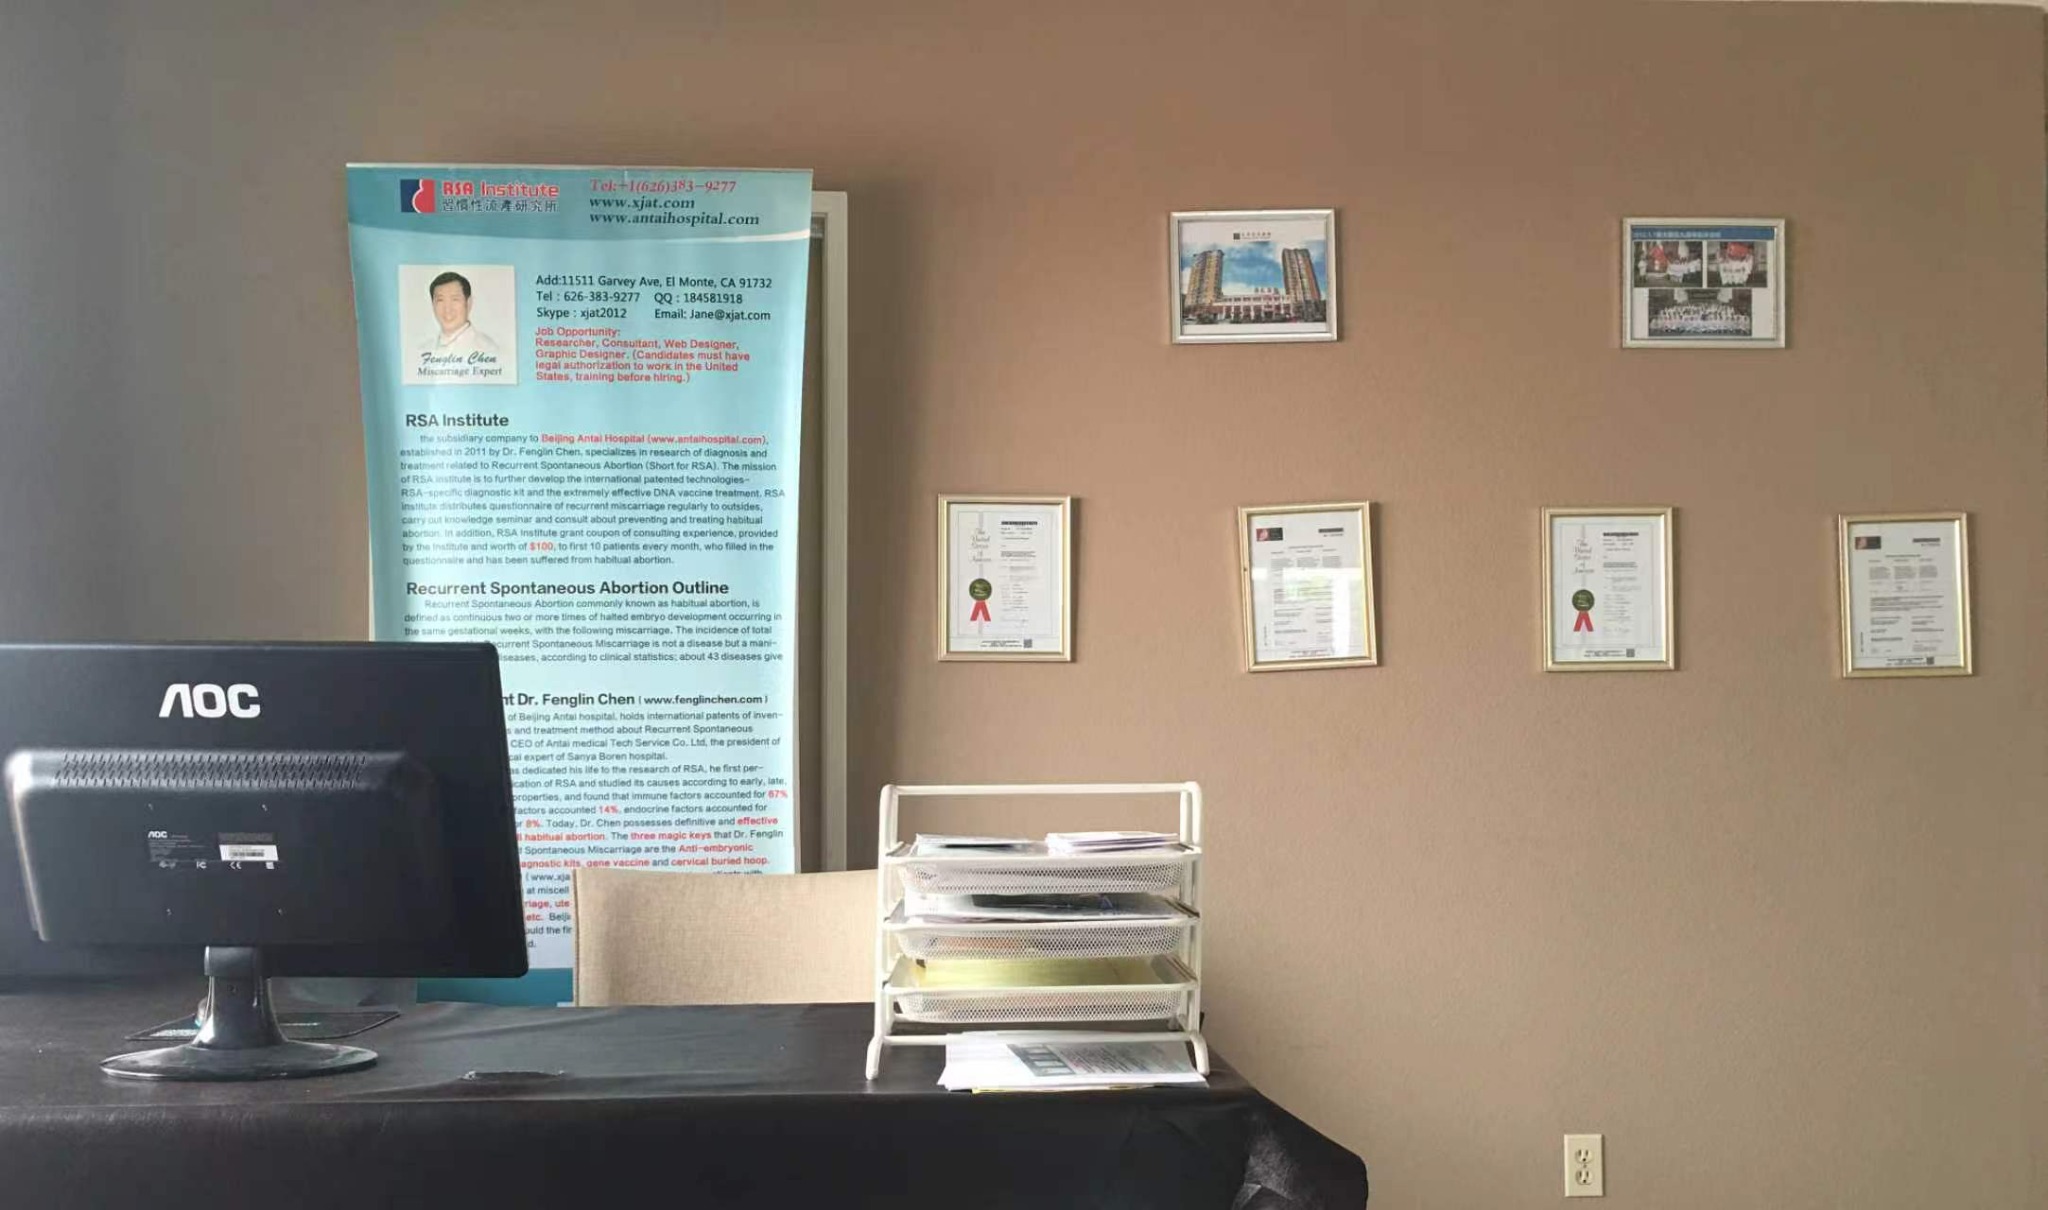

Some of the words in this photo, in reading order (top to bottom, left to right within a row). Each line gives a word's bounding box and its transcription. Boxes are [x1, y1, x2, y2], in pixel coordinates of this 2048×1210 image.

[442, 181, 474, 196] RSA
[481, 181, 560, 197] Institute
[590, 196, 695, 211] www.xjat.com
[590, 212, 760, 227] www.antaihospital.com
[536, 275, 594, 286] Add:11511
[598, 276, 636, 289] Garvey
[639, 276, 662, 289] Ave,
[666, 276, 675, 287] El
[680, 277, 718, 289] Monte,
[721, 277, 736, 288] CA
[739, 277, 772, 288] 91732
[537, 290, 552, 301] Tel
[564, 291, 640, 302] 626-383-9277
[654, 292, 673, 304] QQ
[684, 292, 743, 303] 184581918
[537, 307, 570, 320] Skype
[580, 307, 627, 321] xjat2012
[655, 308, 688, 319] Email:
[689, 309, 771, 322] Jane@xjat.com
[536, 327, 553, 336] Job
[556, 327, 620, 338] Opportunity:
[602, 338, 661, 349] Consultant,
[664, 339, 687, 348] Web
[690, 339, 740, 350] Designer,
[468, 350, 496, 364] Chen
[536, 349, 576, 360] Graphic
[633, 350, 694, 361] (Candidates
[698, 351, 722, 360] must
[725, 351, 750, 360] have
[536, 360, 561, 371] legal
[564, 360, 632, 370] authorization
[634, 361, 644, 370] to
[646, 361, 672, 370] work
[674, 361, 683, 370] in
[686, 361, 702, 371] the
[705, 361, 738, 371] United
[417, 367, 469, 377] Miscarriage
[473, 367, 502, 377] Expert
[537, 371, 573, 381] States,
[576, 371, 614, 382] training
[617, 372, 651, 381] before
[654, 372, 690, 383] hiring.)
[406, 414, 439, 427] RSA
[443, 414, 509, 427] Institute
[420, 434, 434, 443] the
[437, 434, 484, 444] subsidiary
[486, 436, 528, 445] company
[529, 435, 539, 443] to
[541, 435, 575, 445] Beijing
[577, 435, 602, 443] Antai
[605, 435, 645, 445] Hospital
[400, 448, 452, 456] established
[454, 448, 462, 456] in
[464, 448, 486, 456] 2011
[489, 448, 500, 458] by
[502, 448, 518, 457] Dr.
[519, 448, 553, 458] Fenglin
[586, 448, 637, 459] specializes
[639, 448, 648, 457] in
[649, 448, 690, 457] research
[693, 449, 702, 457] of
[704, 449, 748, 459] diagnosis
[750, 449, 768, 458] and
[400, 461, 444, 470] treatment
[446, 461, 478, 470] related
[480, 461, 490, 470] to
[492, 461, 538, 470] Recurrent
[540, 461, 602, 472] Spontaneous
[603, 461, 643, 470] Abortion
[646, 462, 675, 472] (Short
[677, 462, 690, 470] for
[723, 462, 740, 470] The
[742, 462, 776, 471] mission
[407, 582, 486, 594] Recurrent
[490, 582, 596, 597] Spontaneous
[600, 582, 669, 594] Abortion
[673, 582, 730, 594] Outline
[425, 599, 470, 608] Recurrent
[471, 599, 532, 609] Spontaneous
[535, 599, 574, 608] Abortion
[577, 599, 622, 609] commonly
[625, 599, 656, 607] known
[671, 599, 708, 607] habitual
[710, 599, 750, 608] abortion,
[752, 599, 760, 607] is
[159, 683, 261, 718] AOC
[517, 693, 539, 705] Dr.
[543, 693, 594, 708] Fenglin
[598, 693, 635, 705] Chen
[644, 695, 763, 706] www.fenglinchen.com
[508, 712, 516, 721] of
[519, 712, 551, 722] Beijing
[553, 712, 577, 720] Antai
[620, 711, 645, 720] holds
[647, 711, 704, 719] international
[706, 710, 740, 720] patents
[742, 710, 752, 719] of
[510, 739, 532, 748] CEO
[535, 739, 544, 748] of
[546, 739, 570, 747] Antai
[572, 738, 608, 747] medical
[611, 738, 634, 747] Tech
[635, 738, 670, 747] Service
[710, 737, 725, 746] the
[727, 737, 770, 747] president
[772, 737, 781, 746] of
[524, 752, 554, 762] expert
[556, 752, 565, 760] of
[567, 751, 597, 762] Sanya
[599, 751, 628, 760] Boren
[564, 792, 581, 800] and
[584, 791, 610, 800] found
[612, 791, 630, 800] that
[632, 791, 668, 799] immune
[670, 791, 702, 799] factors
[704, 790, 752, 799] accounted
[754, 790, 766, 798] for
[525, 832, 564, 840] habitual
[611, 831, 629, 839] The
[631, 831, 656, 839] three
[658, 831, 687, 840] magic
[689, 830, 712, 840] keys
[714, 830, 732, 838] that
[734, 830, 749, 838] Dr.
[750, 830, 784, 840] Fenglin
[587, 859, 610, 868] gene
[613, 858, 650, 866] vaccine
[652, 857, 670, 866] and
[671, 857, 709, 865] cervical
[711, 857, 742, 865] buried
[744, 856, 770, 866] hoop.
